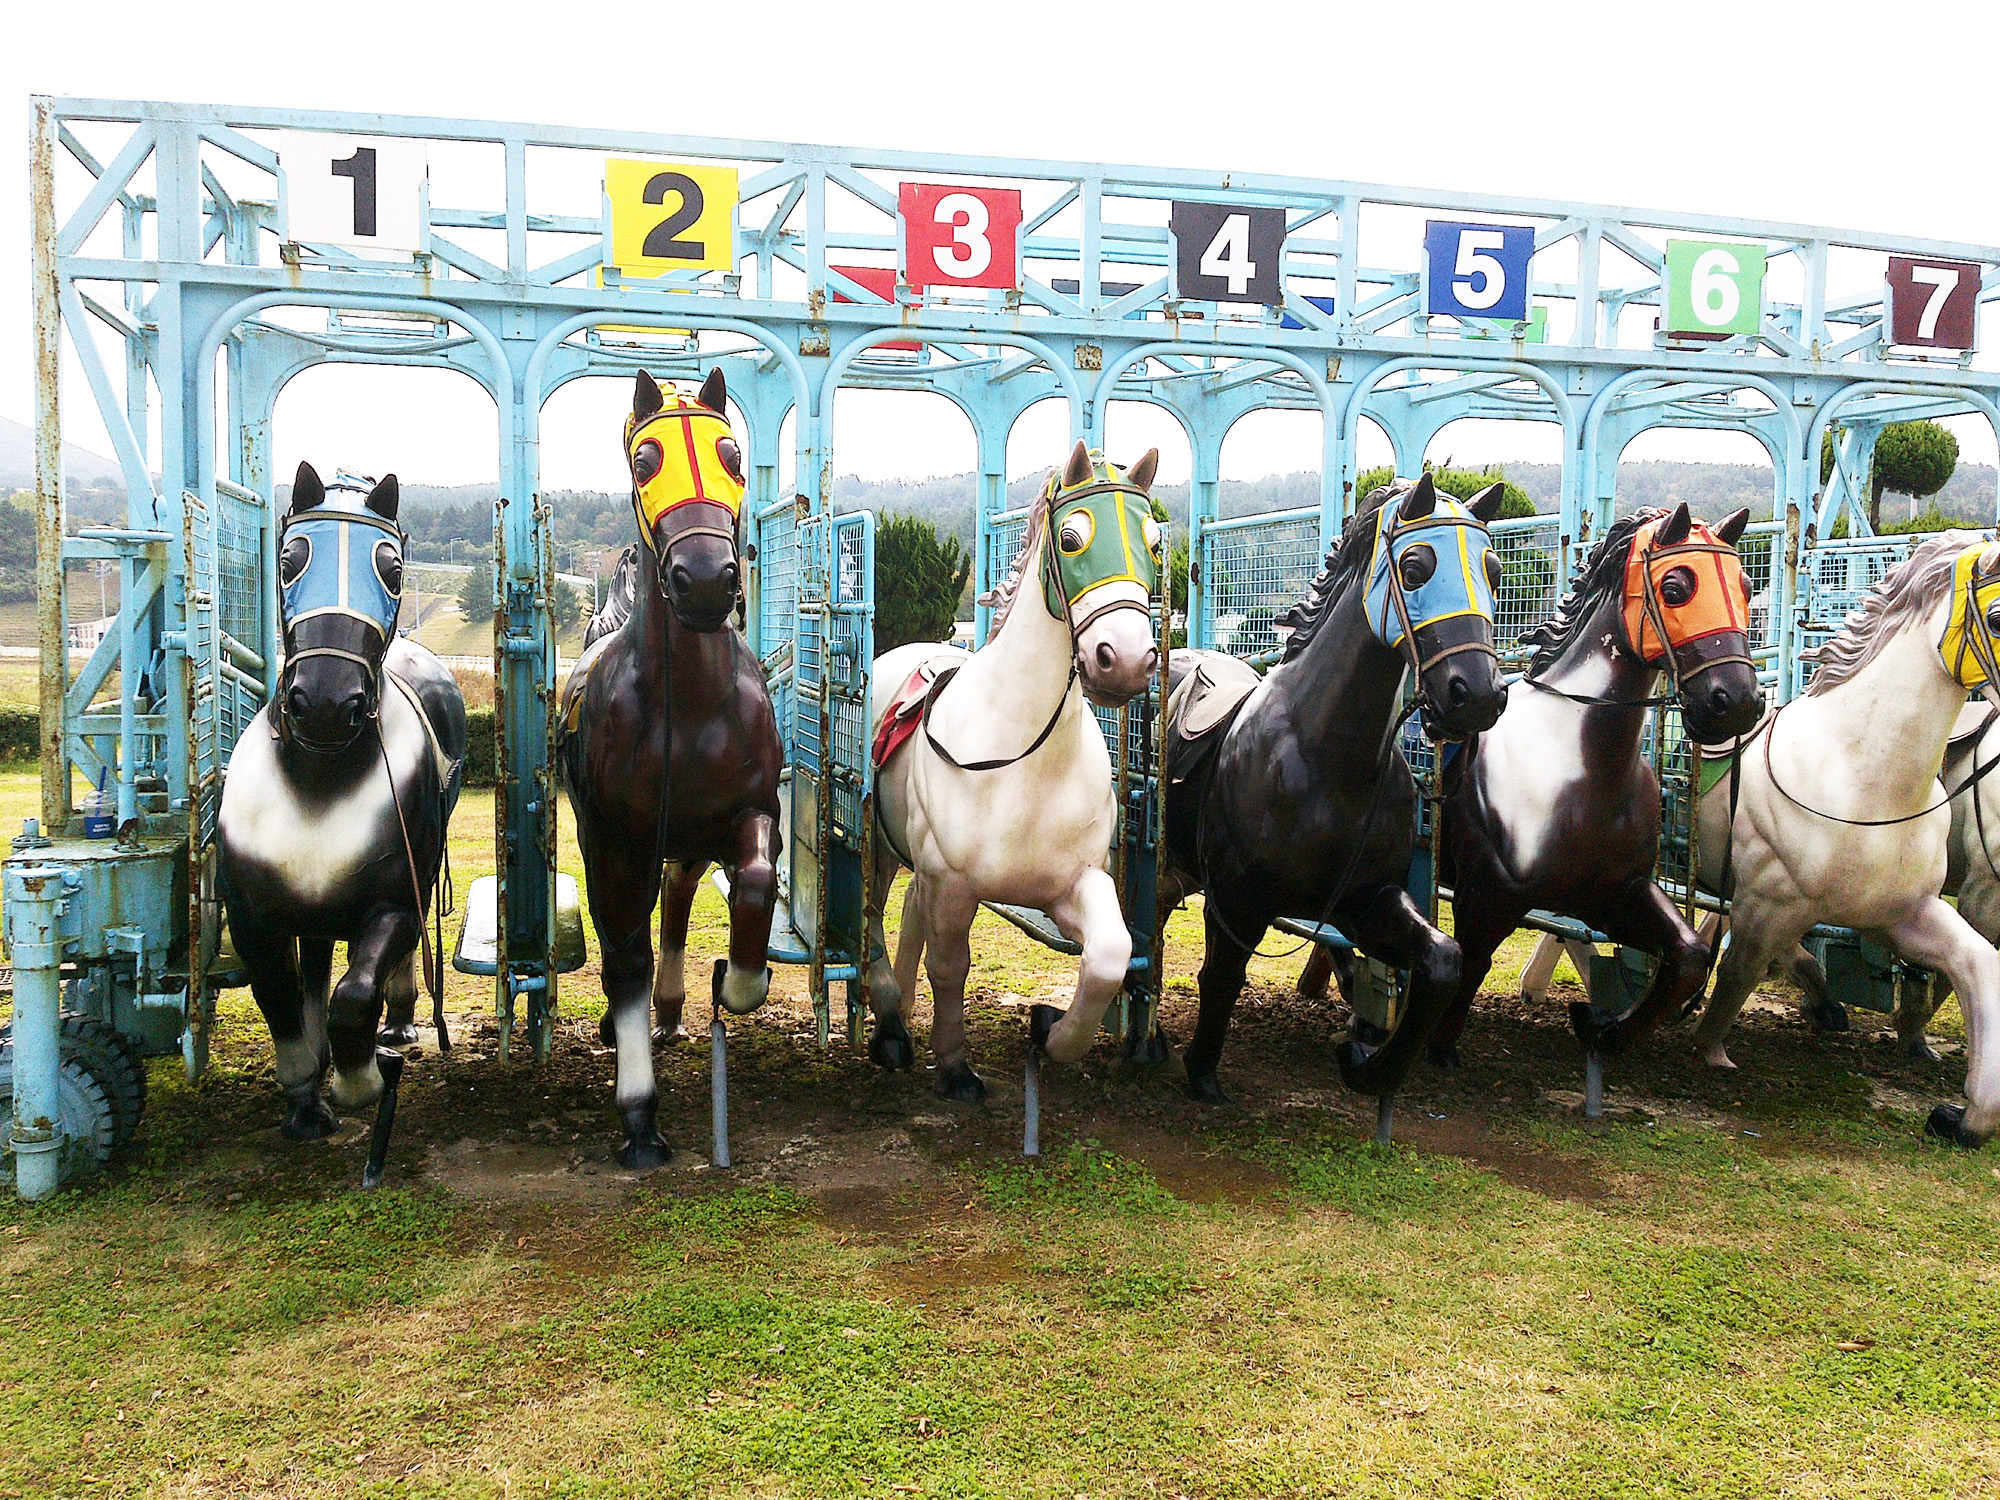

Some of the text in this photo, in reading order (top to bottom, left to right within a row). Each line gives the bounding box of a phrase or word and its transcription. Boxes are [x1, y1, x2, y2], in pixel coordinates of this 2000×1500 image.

[331, 147, 377, 237] 1
[641, 172, 705, 260] 2
[932, 193, 992, 279] 3
[1199, 214, 1256, 295] 4
[1451, 229, 1506, 309] 5
[1690, 247, 1740, 326] 6
[1911, 265, 1960, 340] 7
